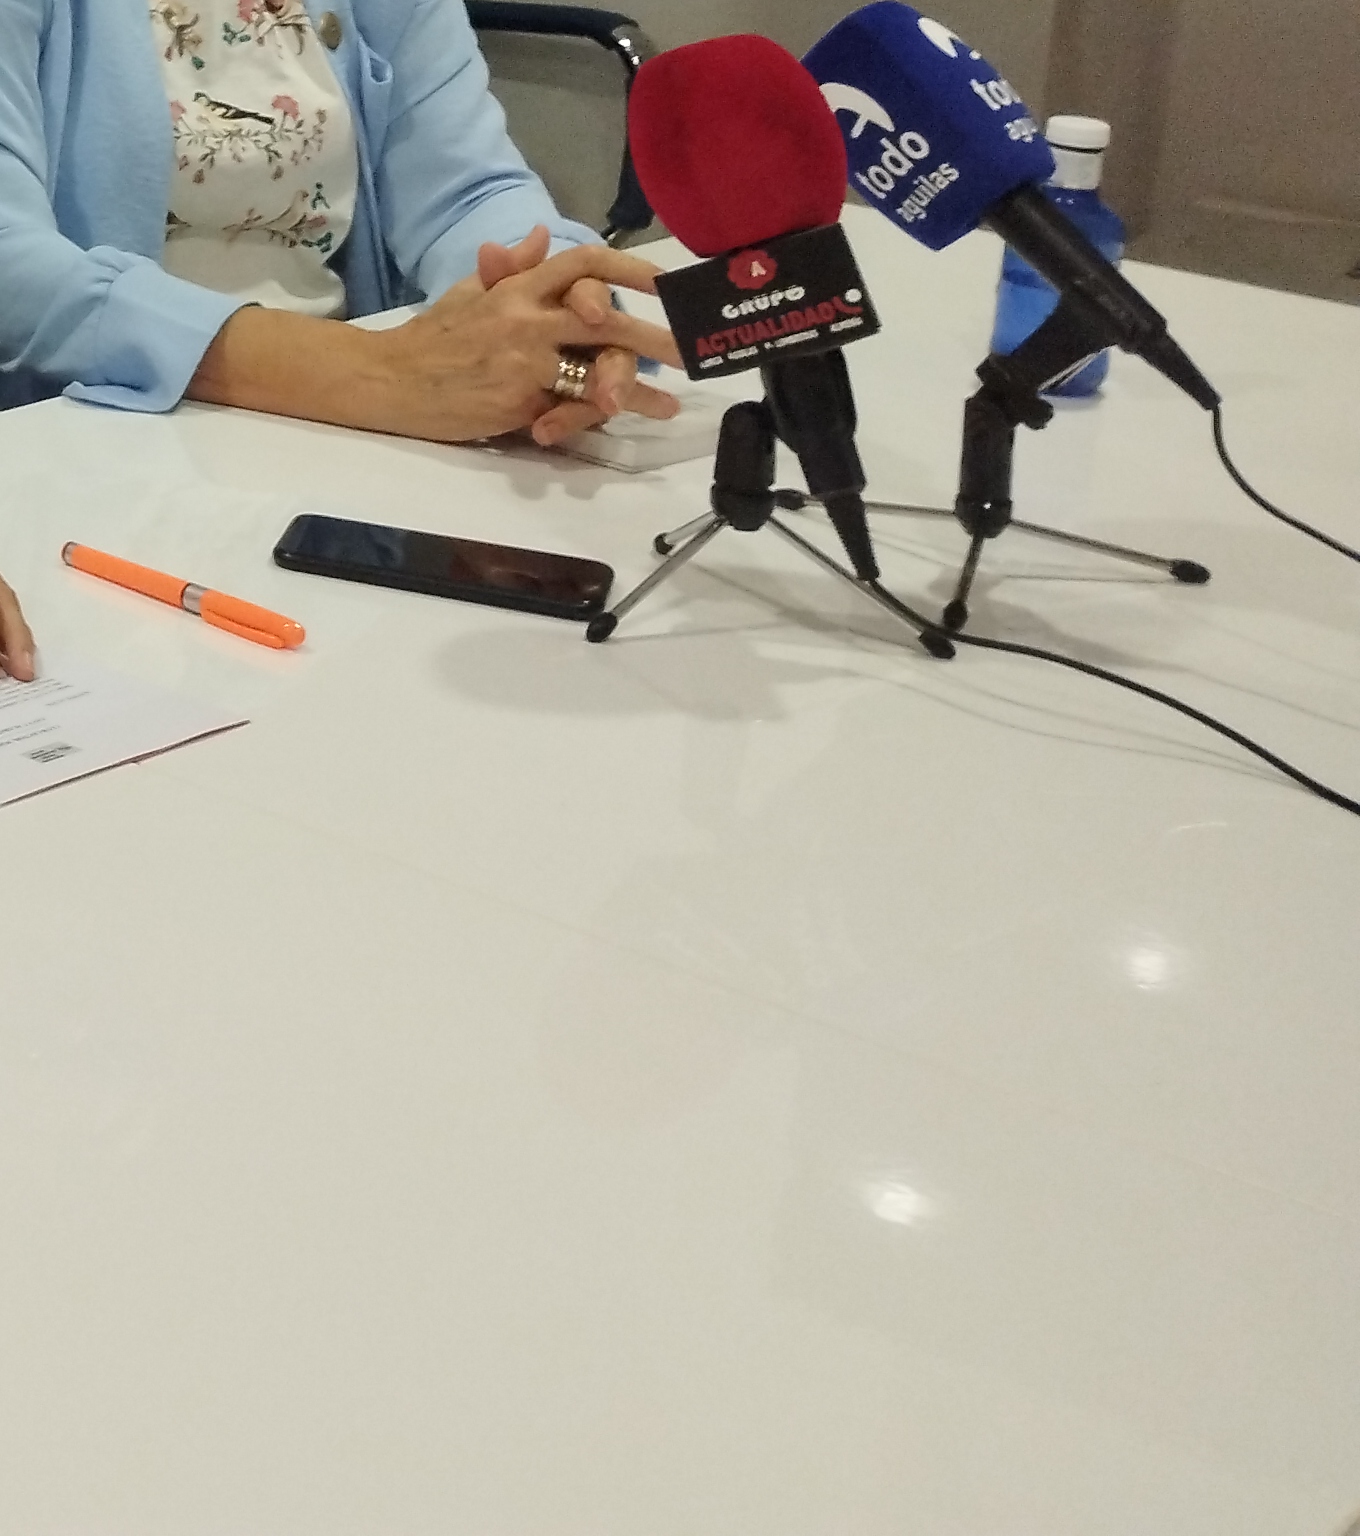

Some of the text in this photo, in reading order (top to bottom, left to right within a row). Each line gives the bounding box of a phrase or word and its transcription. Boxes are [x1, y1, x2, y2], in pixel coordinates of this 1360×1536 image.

[854, 130, 931, 200] todo
[750, 260, 768, 278] A
[721, 284, 806, 320] GRUPO
[695, 301, 836, 358] ACTUALIDAD
